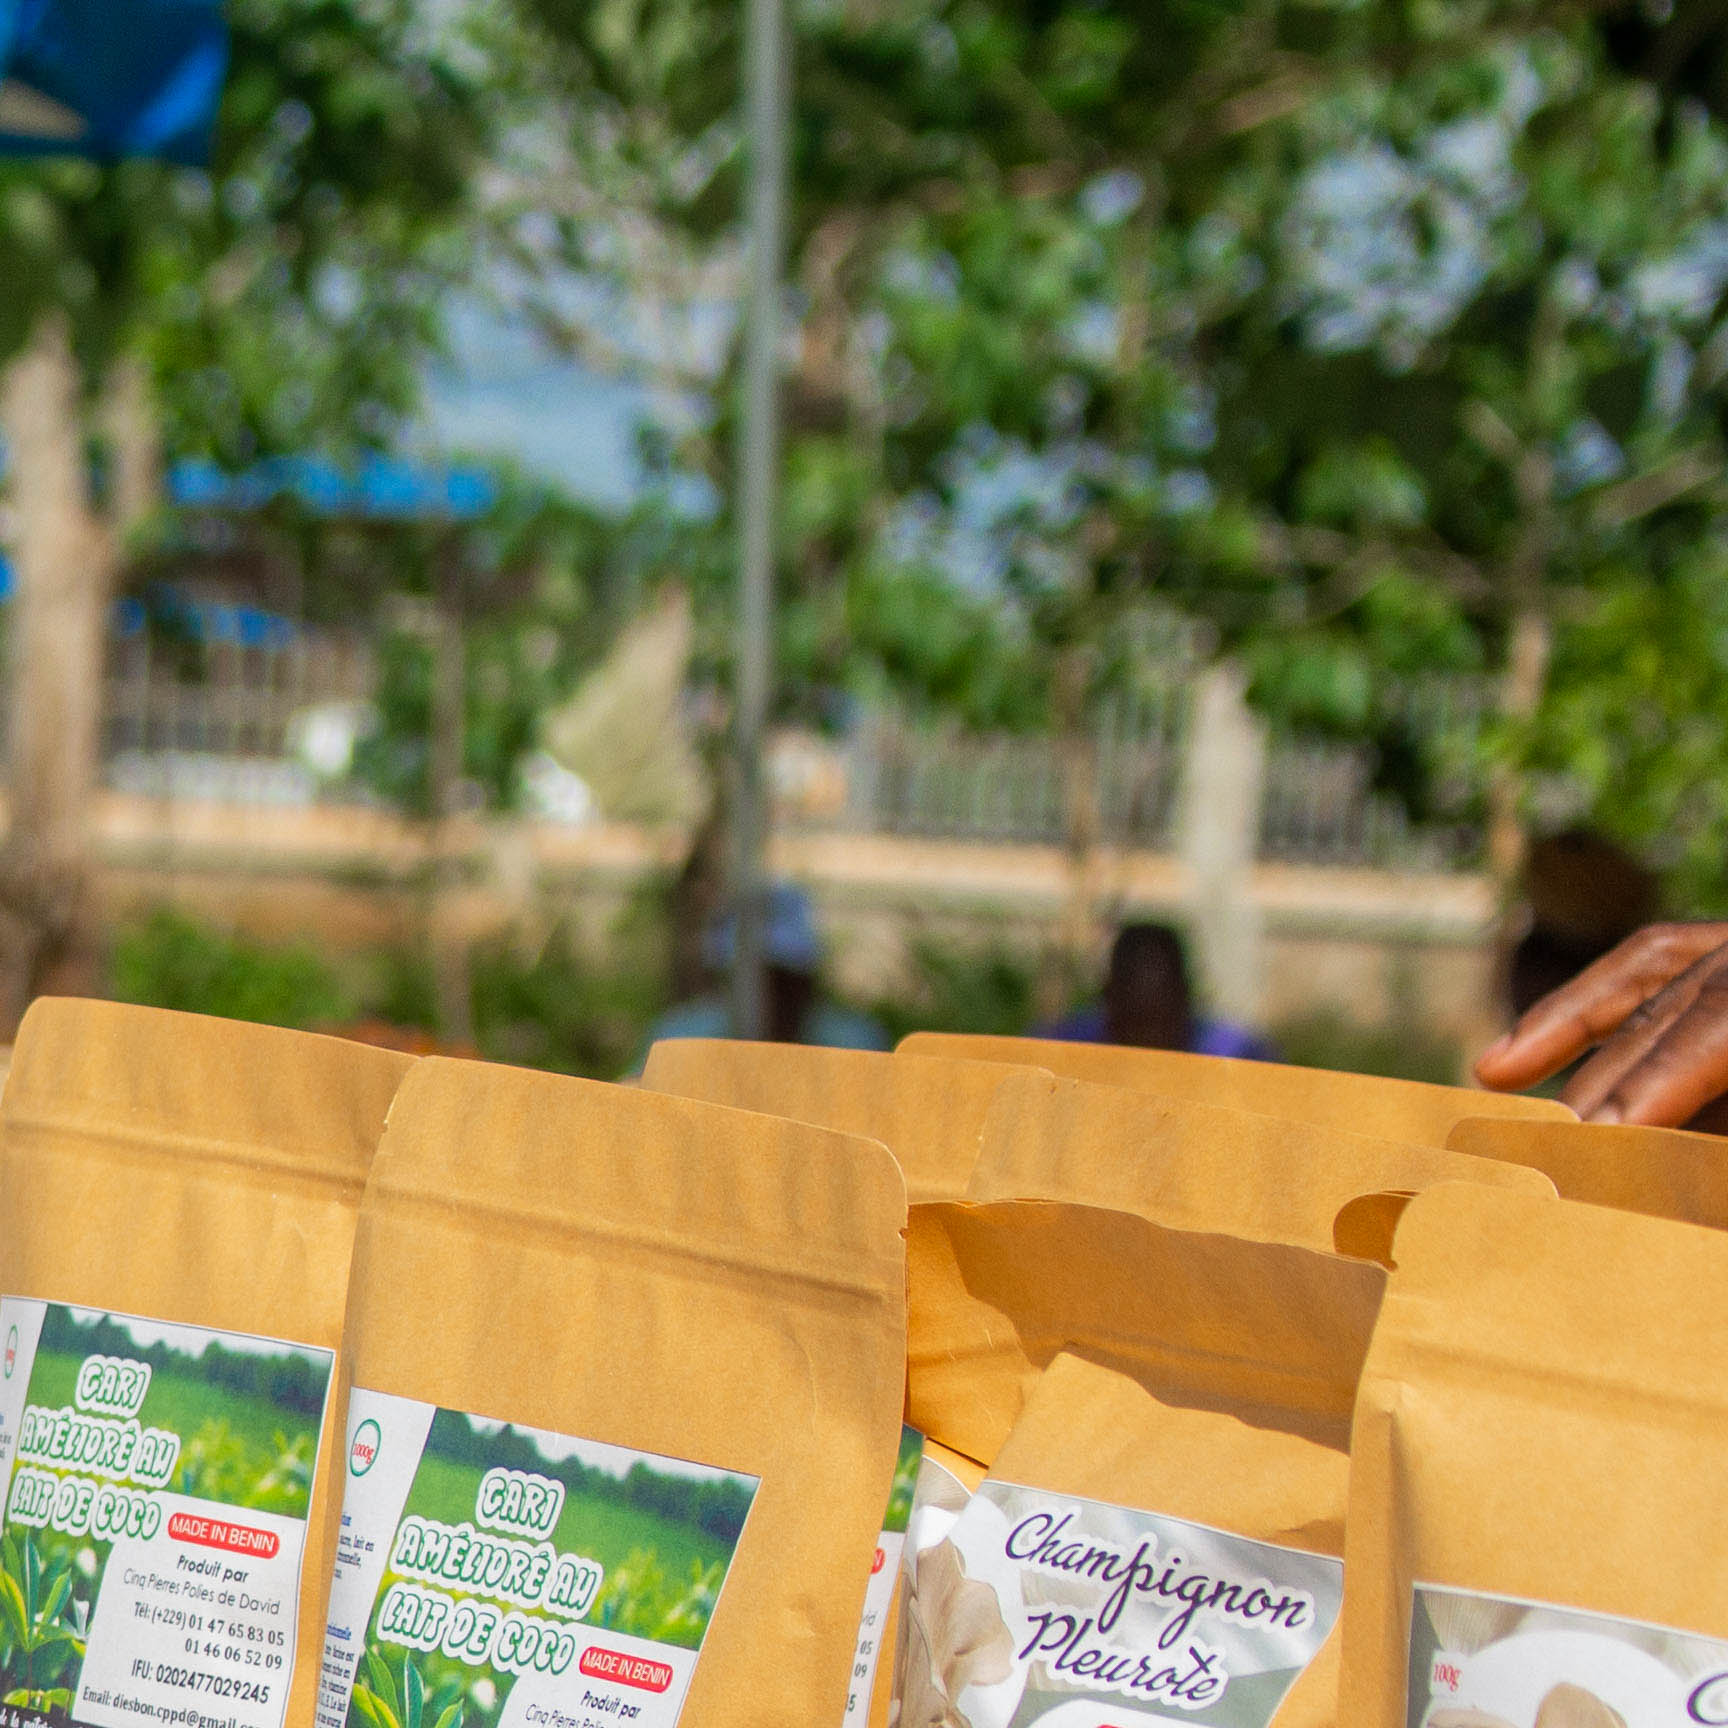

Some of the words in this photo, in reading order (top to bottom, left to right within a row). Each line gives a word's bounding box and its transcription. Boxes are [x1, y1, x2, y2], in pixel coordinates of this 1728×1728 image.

[78, 1359, 148, 1412] GARI
[19, 1409, 138, 1474] AMÉLIORÉ
[10, 1474, 55, 1519] LAIT
[55, 1481, 94, 1528] DE
[94, 1489, 162, 1541] COCO
[479, 1474, 560, 1532] GARI
[172, 1517, 207, 1538] MADE
[211, 1524, 227, 1542] IN
[229, 1528, 276, 1552] BENIN
[176, 1554, 221, 1578] Produit
[222, 1566, 250, 1584] par
[395, 1523, 551, 1600] AMÉLIORÉ
[123, 1568, 146, 1587] Cinq
[147, 1573, 181, 1595] Pierres
[182, 1581, 214, 1602] Polies
[218, 1590, 236, 1607] de
[239, 1593, 280, 1616] David
[1005, 1514, 1307, 1650] Champignon
[151, 1606, 186, 1630] (+229)
[188, 1614, 203, 1630] 01
[208, 1619, 225, 1634] 47
[228, 1622, 244, 1639] 65
[247, 1626, 264, 1642] 83
[267, 1629, 285, 1646] 05
[382, 1591, 447, 1642] LAIT
[447, 1606, 496, 1655] DE
[497, 1619, 576, 1675] COCO
[185, 1638, 200, 1654] 01
[203, 1641, 220, 1658] 46
[224, 1645, 241, 1662] 06
[245, 1649, 261, 1666] 52
[265, 1654, 283, 1670] 09
[860, 1640, 873, 1655] 05
[1018, 1612, 1219, 1700] Pleurote
[131, 1658, 153, 1681] IFU:
[156, 1664, 270, 1704] 0202477029245
[583, 1651, 615, 1674] MADE
[618, 1660, 632, 1679] IN
[633, 1663, 671, 1687] BENIN
[854, 1663, 867, 1678] 09
[1434, 1663, 1462, 1692] 100g
[83, 1686, 112, 1702] Email:
[580, 1690, 619, 1714] Produit
[619, 1702, 641, 1720] par
[525, 1704, 547, 1725] Cinq
